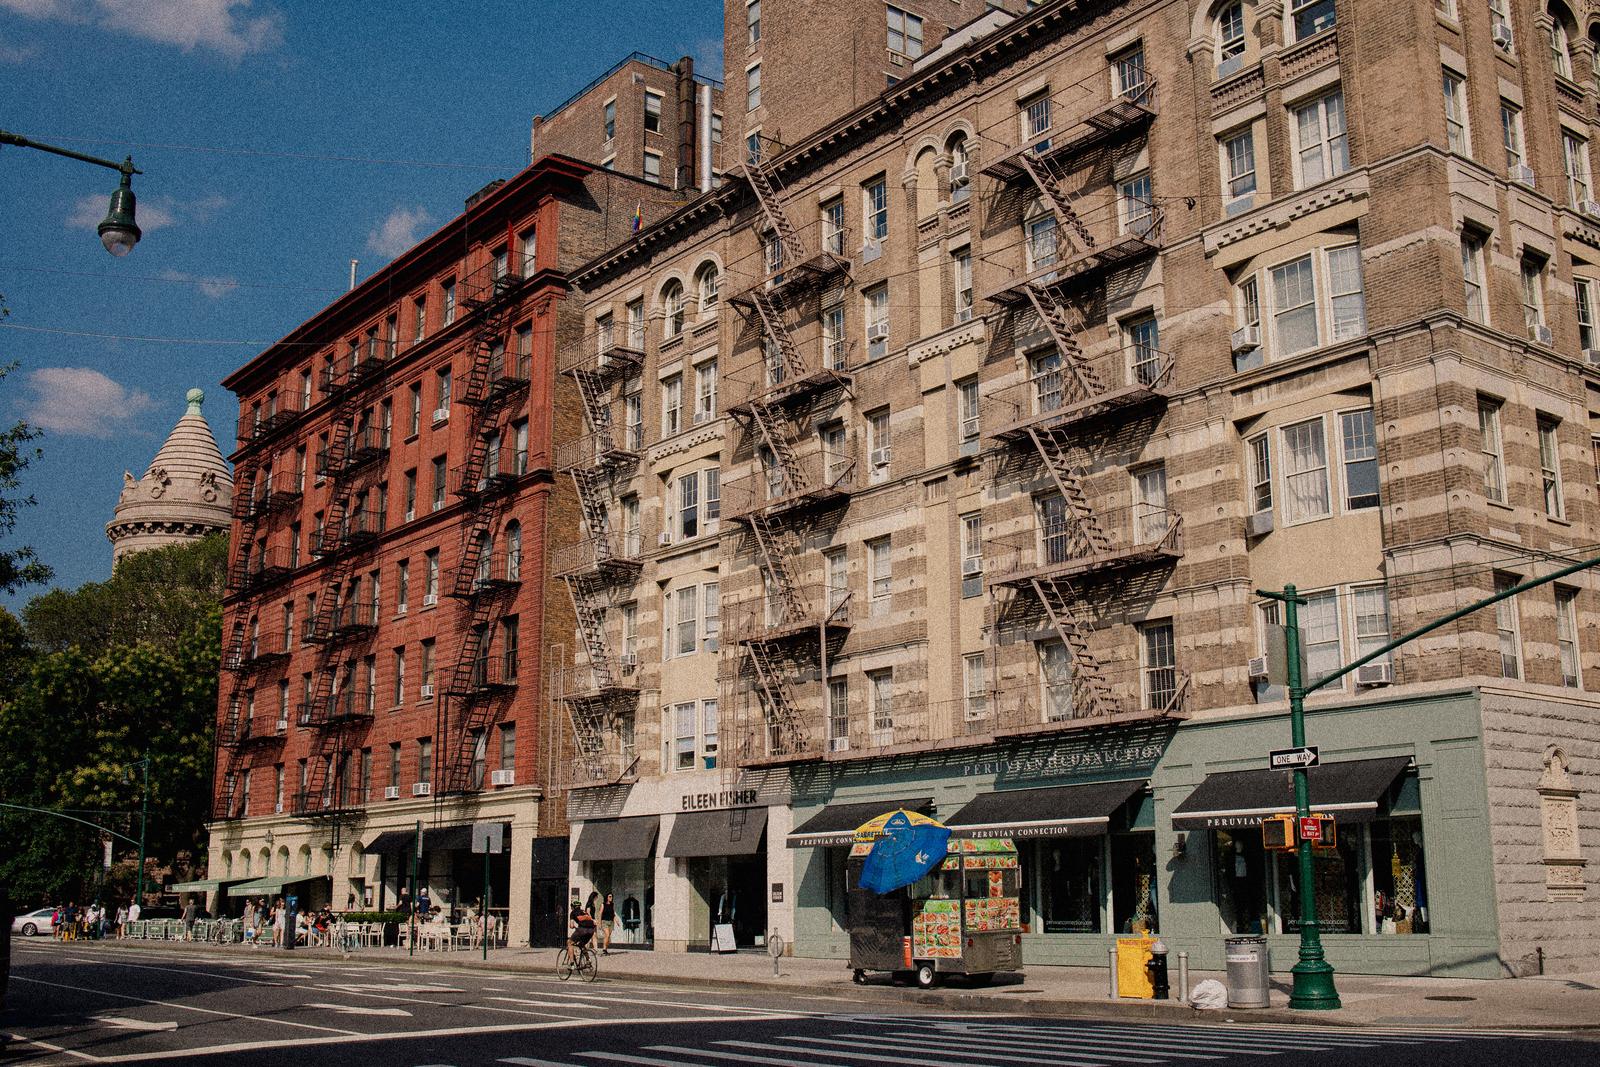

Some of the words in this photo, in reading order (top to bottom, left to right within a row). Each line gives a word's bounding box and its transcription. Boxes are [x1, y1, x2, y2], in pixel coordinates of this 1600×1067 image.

[1276, 755, 1290, 763] ONE
[1297, 753, 1311, 761] WAY
[682, 793, 717, 810] EILEEN
[1207, 816, 1263, 826] PERUVIAN
[972, 829, 1014, 838] PERUVIAN
[1017, 826, 1068, 836] CONNECTION
[800, 838, 833, 846] PERUVIAN
